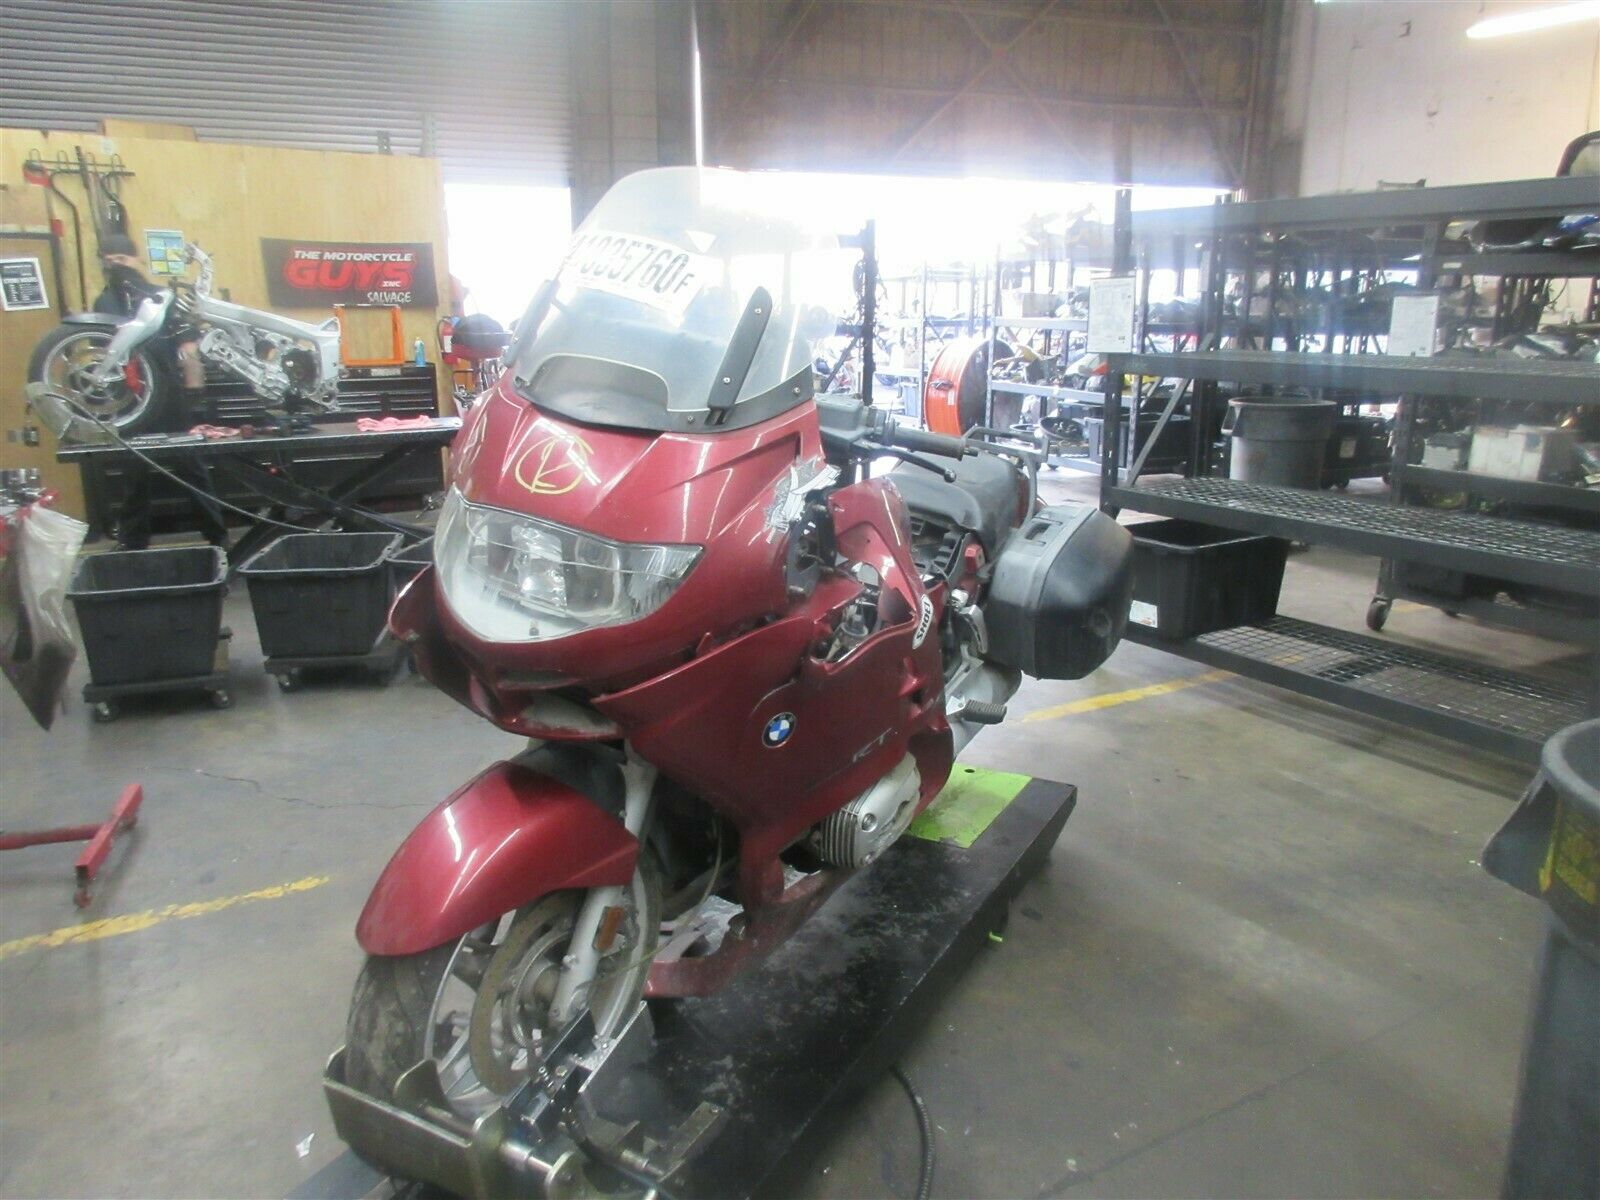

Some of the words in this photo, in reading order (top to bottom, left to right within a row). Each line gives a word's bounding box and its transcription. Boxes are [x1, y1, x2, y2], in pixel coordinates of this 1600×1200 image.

[293, 250, 321, 260] THE
[323, 252, 414, 262] MOTORCYCLE
[285, 259, 416, 289] GUYS
[367, 291, 412, 303] SALVAGE
